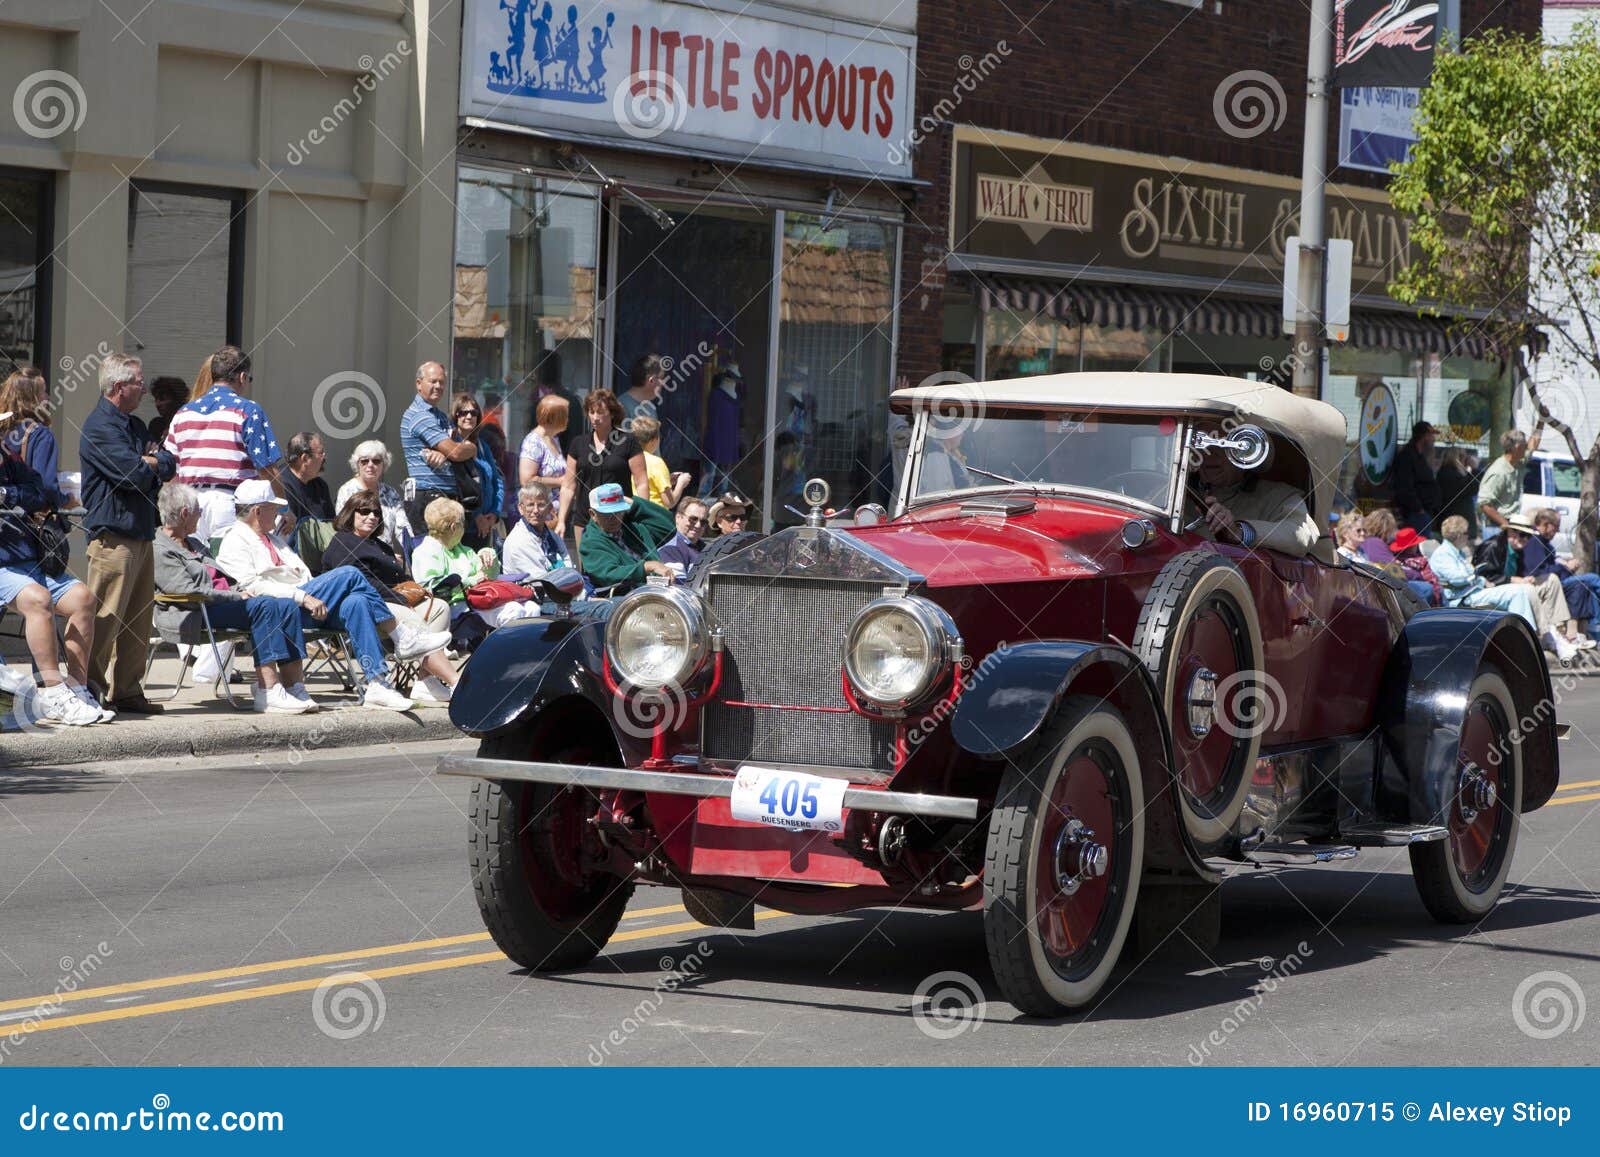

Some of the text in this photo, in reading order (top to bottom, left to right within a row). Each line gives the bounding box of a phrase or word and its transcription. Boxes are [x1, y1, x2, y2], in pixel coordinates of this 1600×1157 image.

[629, 24, 895, 139] LITTLE SPROUTS
[980, 180, 1091, 226] WALK THRU
[1120, 177, 1247, 259] SIXTH
[1329, 206, 1413, 285] MAIN
[759, 776, 822, 819] 405
[761, 815, 812, 828] DUESENBERG
